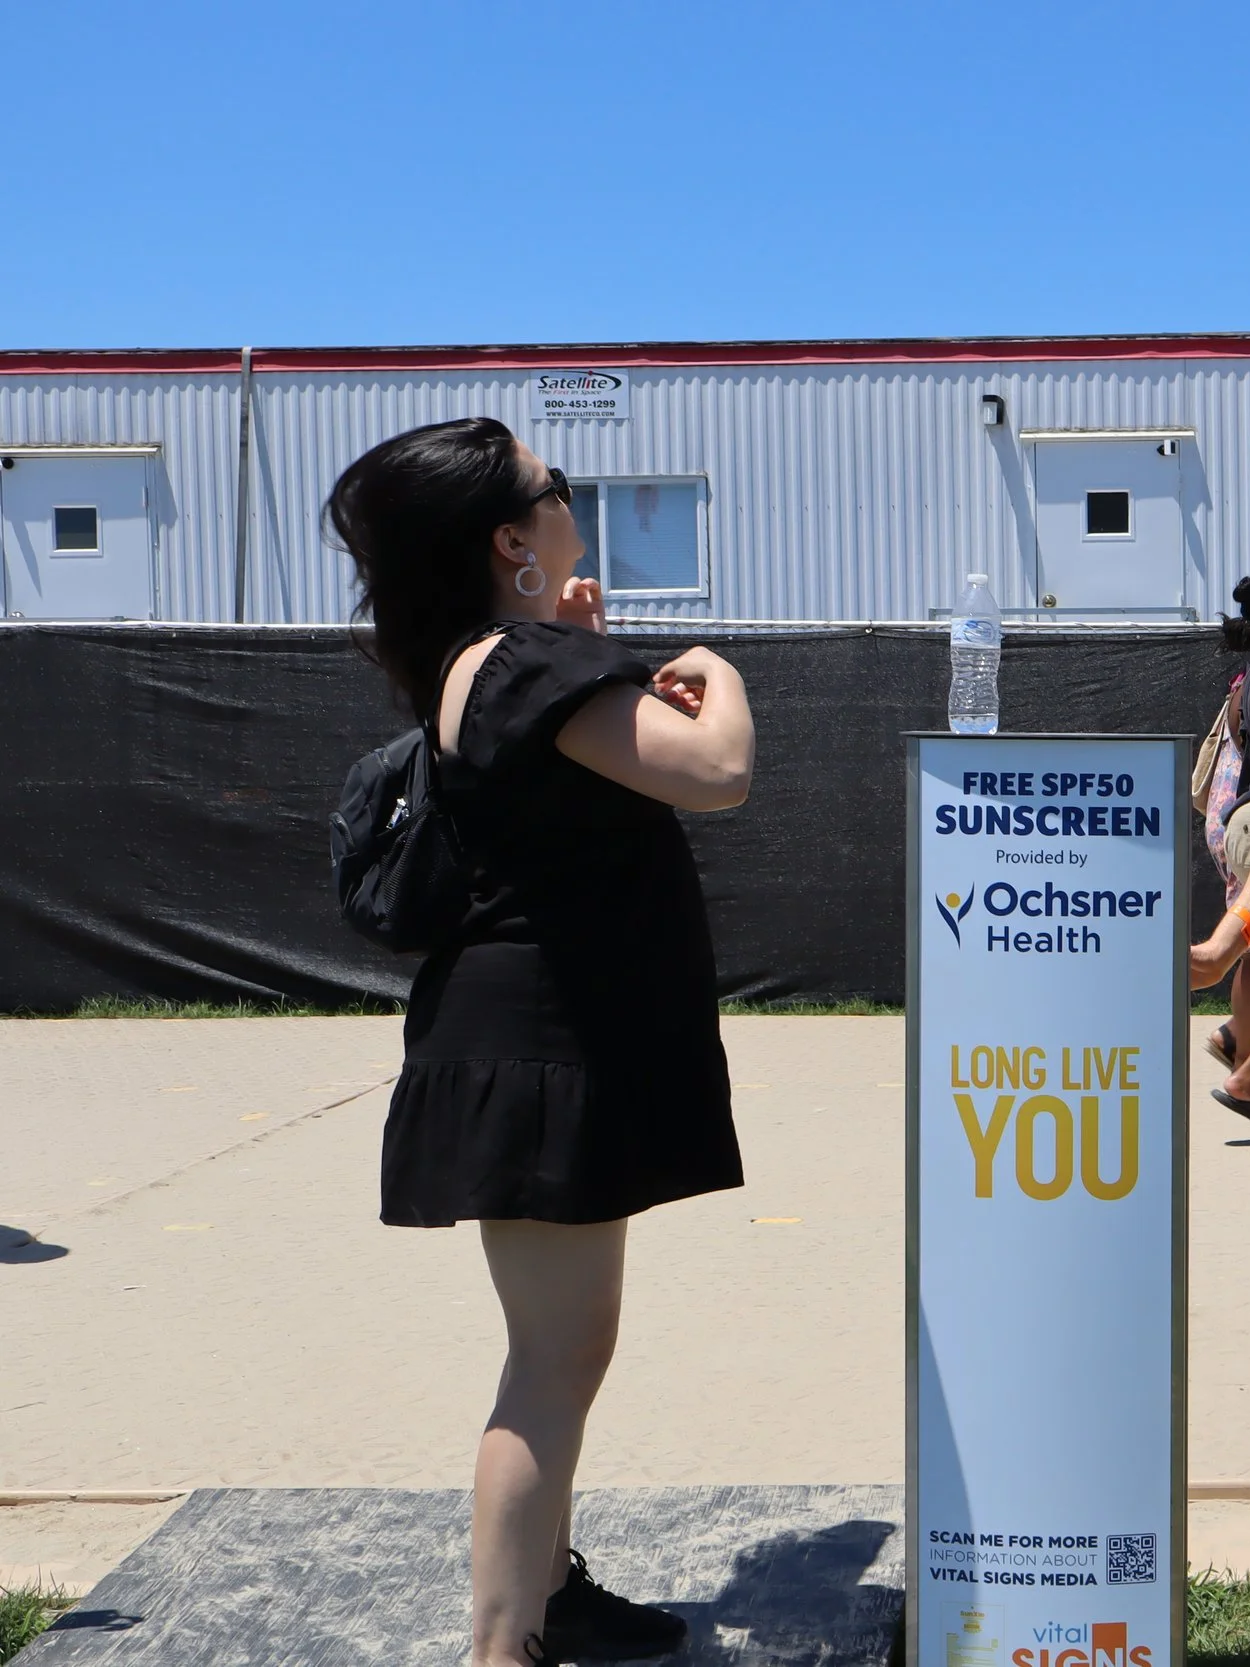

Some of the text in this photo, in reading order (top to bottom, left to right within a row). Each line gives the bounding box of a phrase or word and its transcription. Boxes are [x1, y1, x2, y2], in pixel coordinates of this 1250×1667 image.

[538, 376, 608, 389] Satellite
[545, 400, 616, 408] 800-453-1299
[963, 772, 1135, 797] FREE SPF50
[935, 805, 1160, 836] SUNSCREEN
[996, 850, 1088, 868] Provided by
[983, 882, 1162, 917] Ochsner
[987, 926, 1101, 953] Health
[951, 1045, 1140, 1090] LONG LIVE
[953, 1094, 1139, 1201] YOU
[930, 1530, 1098, 1548] SCAN ME FOR MORE
[930, 1549, 1098, 1566] INFORMATION ABOUT
[930, 1567, 1098, 1586] VITAL SIGNS MEDIA
[1033, 1621, 1087, 1643] vital
